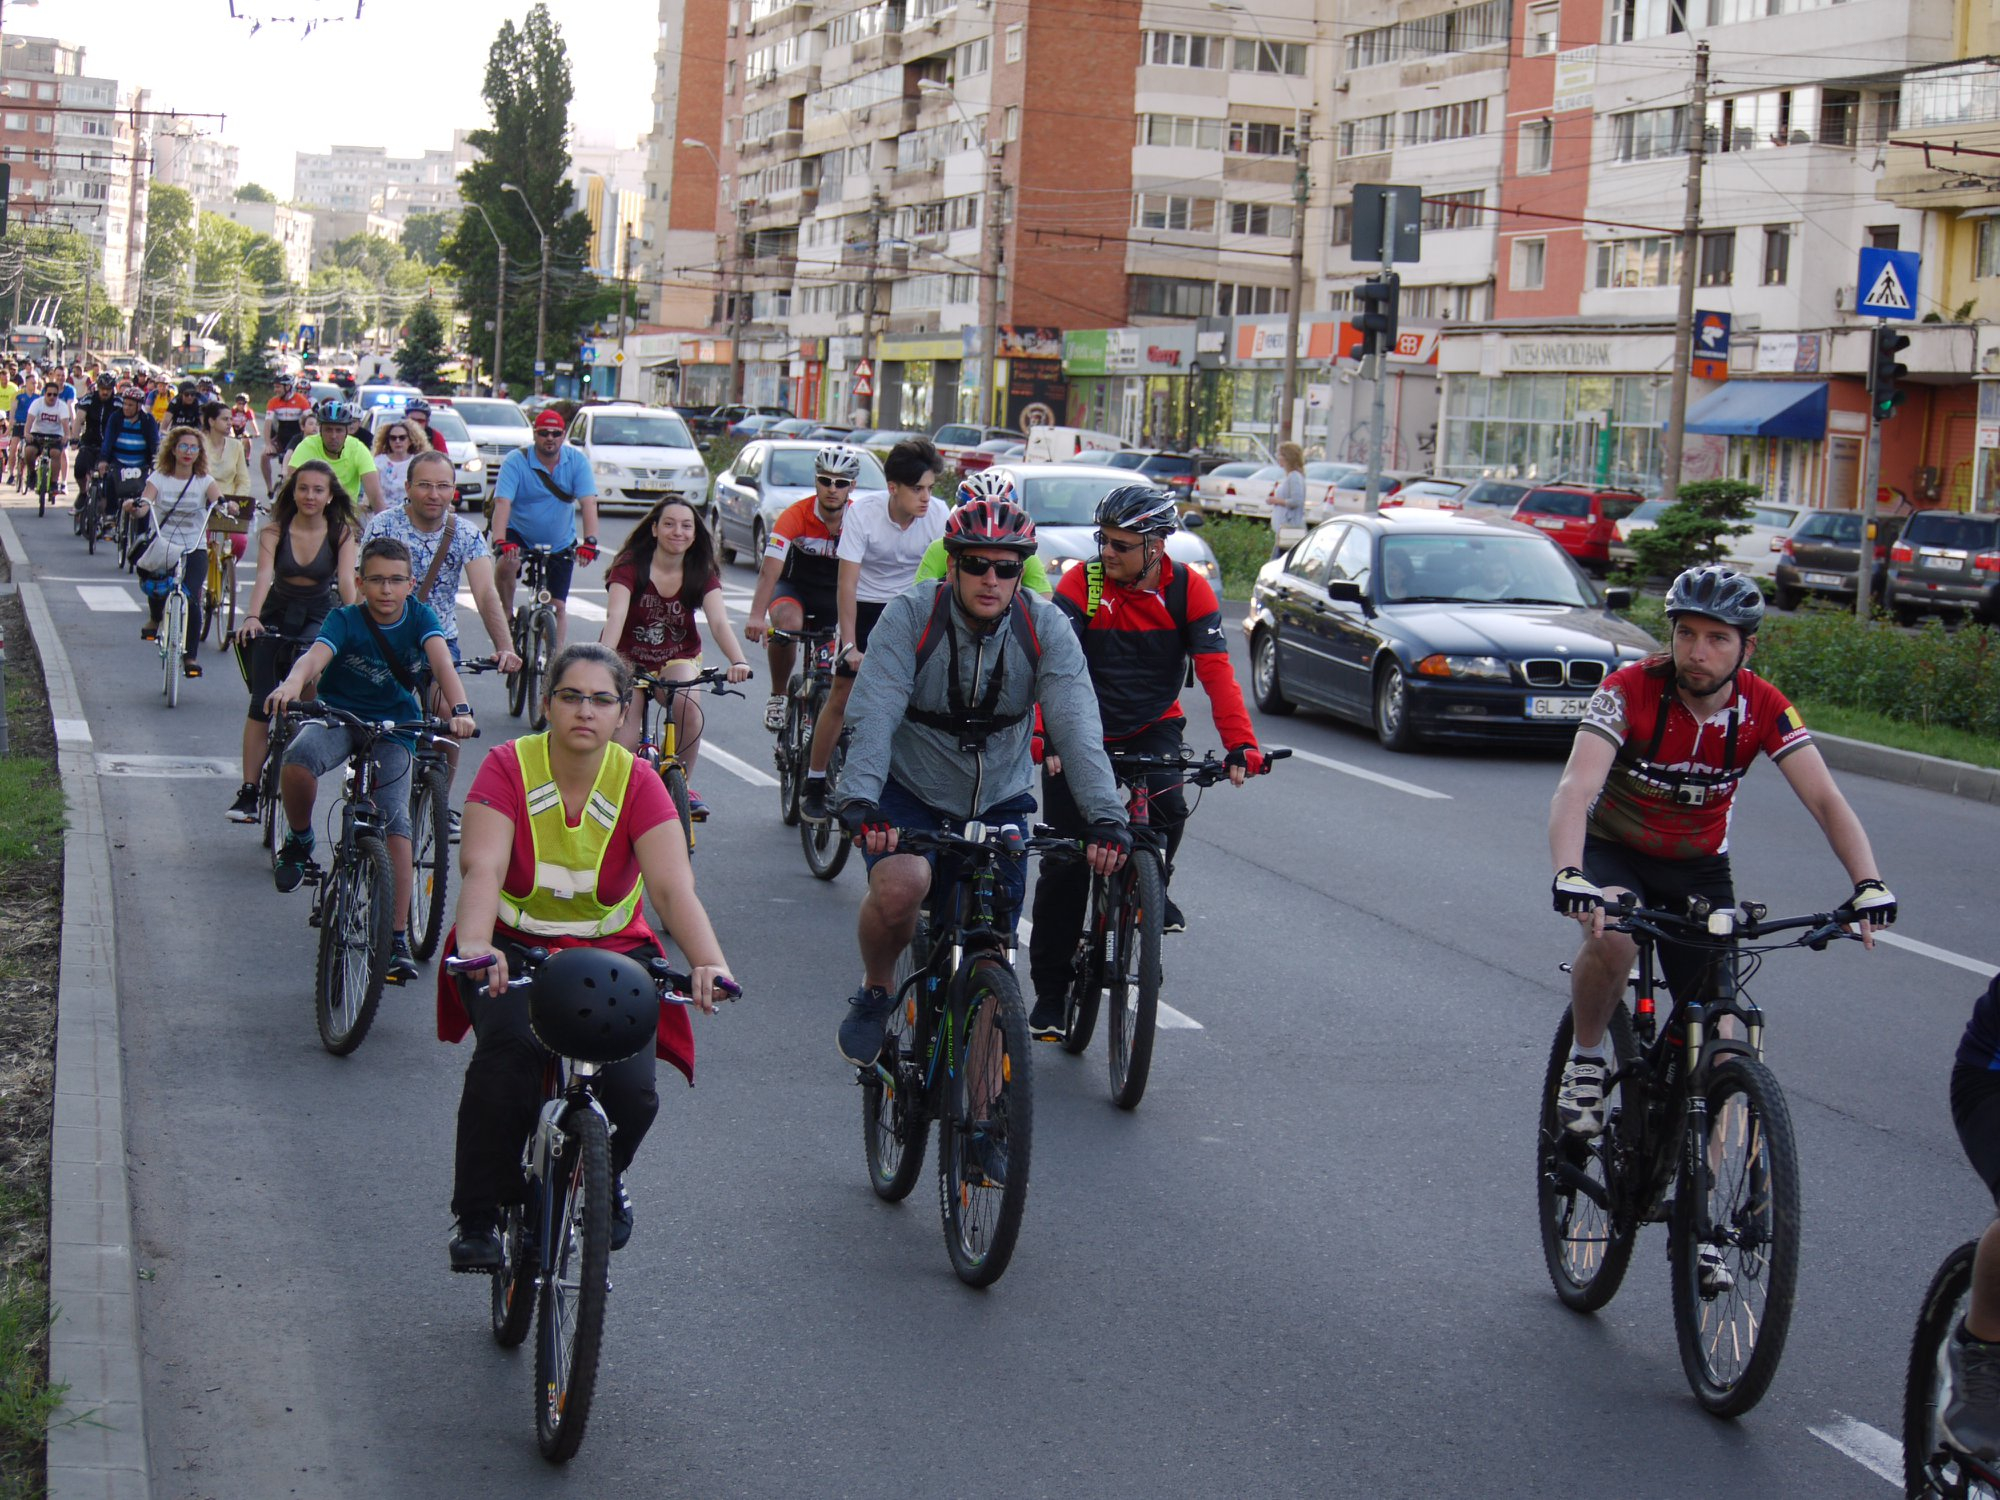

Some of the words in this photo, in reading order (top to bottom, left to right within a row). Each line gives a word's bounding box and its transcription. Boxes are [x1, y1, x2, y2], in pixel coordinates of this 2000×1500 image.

[1585, 342, 1612, 366] BANK
[1087, 561, 1104, 617] arena
[1535, 700, 1553, 714] GL
